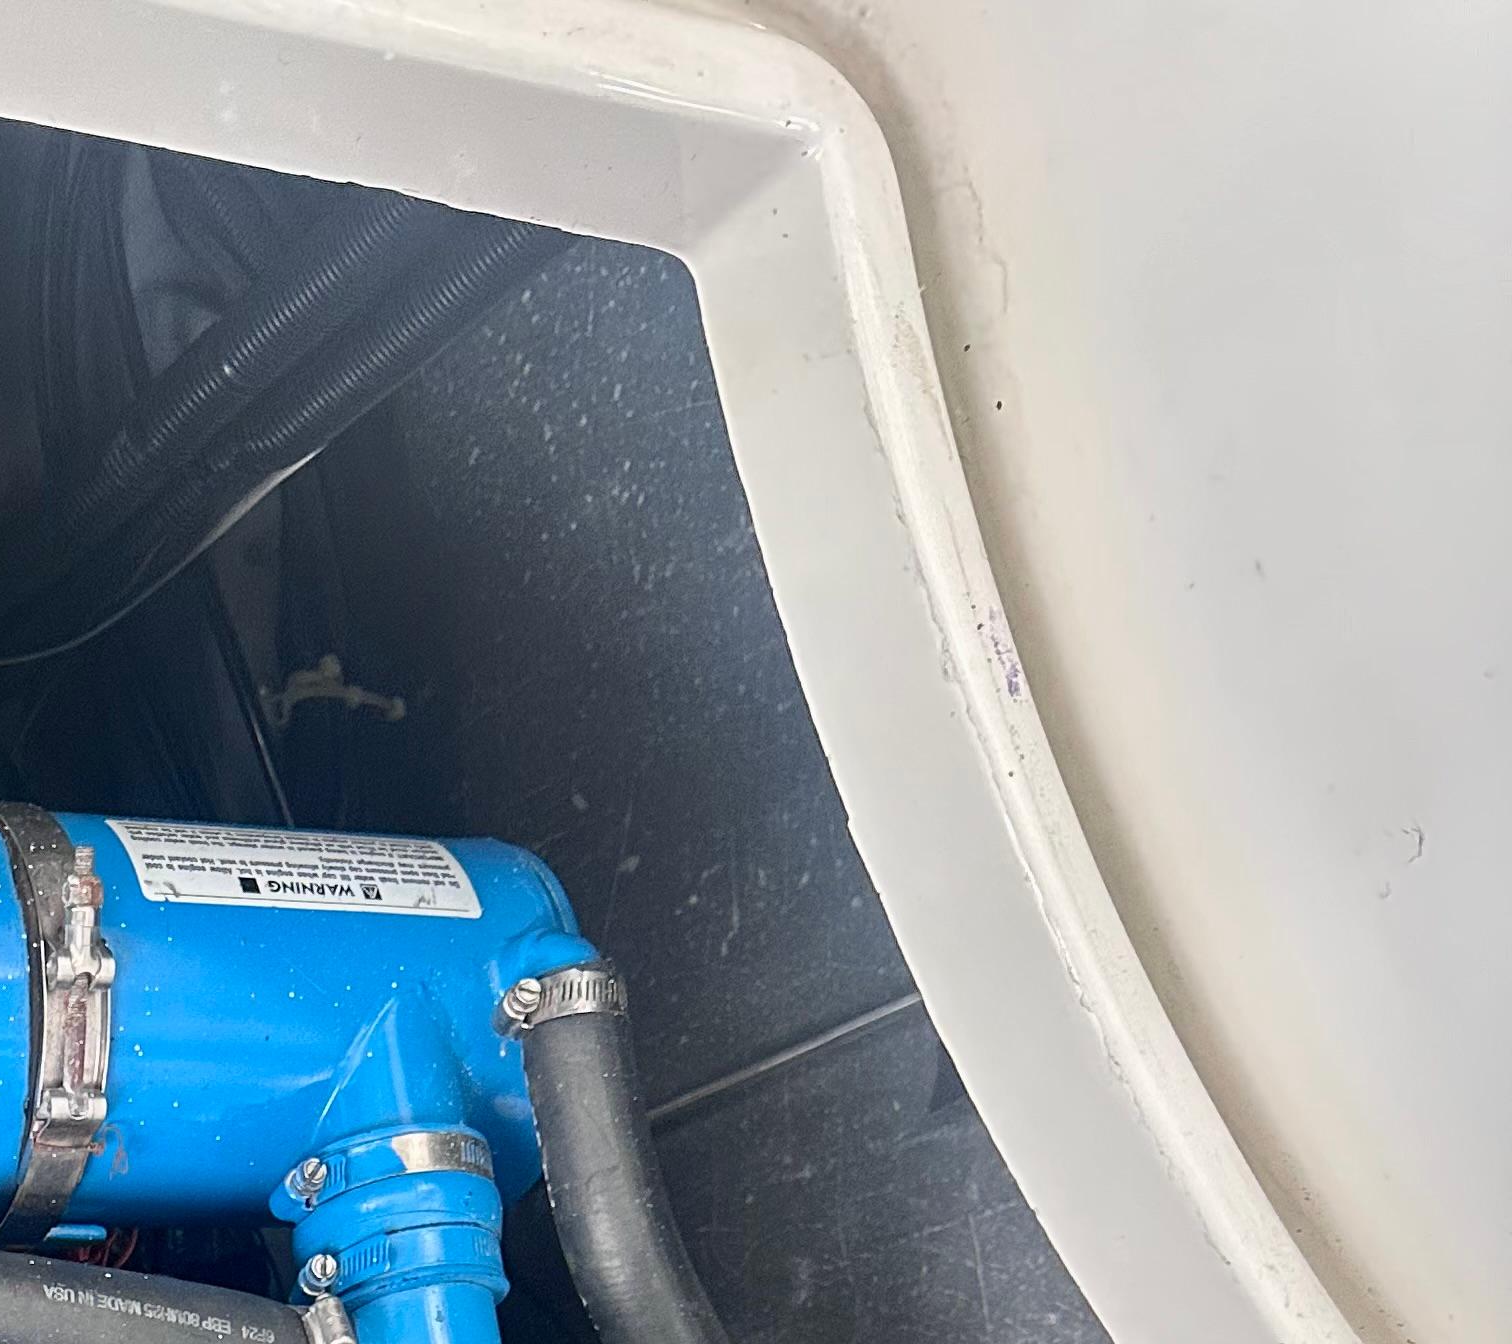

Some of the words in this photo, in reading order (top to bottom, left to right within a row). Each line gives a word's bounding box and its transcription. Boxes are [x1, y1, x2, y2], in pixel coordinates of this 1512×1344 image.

[266, 877, 355, 898] WARNING
[42, 1283, 76, 1303] USA
[77, 1290, 96, 1307] IN
